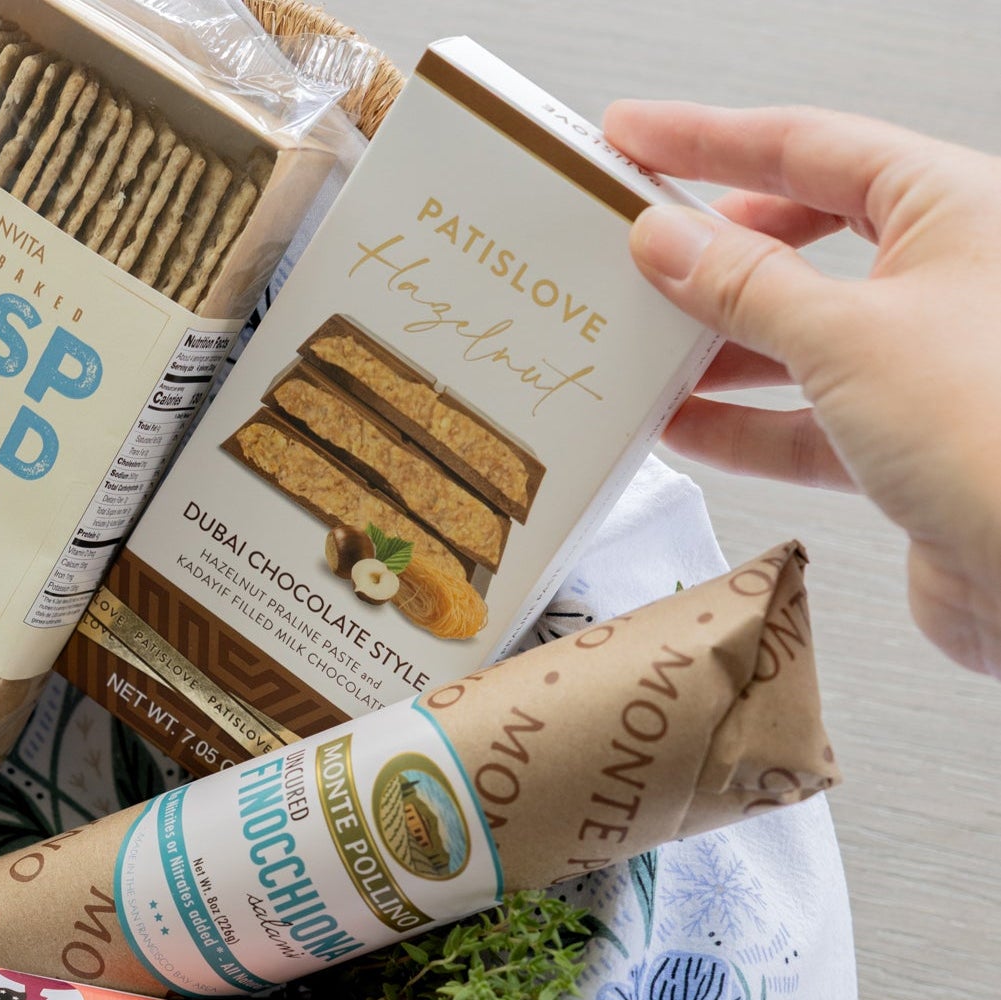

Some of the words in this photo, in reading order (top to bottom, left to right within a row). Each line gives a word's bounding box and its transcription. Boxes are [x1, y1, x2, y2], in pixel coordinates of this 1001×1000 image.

[416, 197, 608, 344] PATISLOVE
[348, 234, 603, 417] Hazelnut
[175, 554, 232, 598] KADAYIF
[230, 593, 274, 634] FILLED
[273, 627, 307, 658] MILK
[182, 501, 248, 556] DUBAI
[248, 550, 372, 650] CHOCOLATE
[369, 640, 431, 693] STYLE
[200, 547, 268, 604] HAZELNUT
[266, 596, 322, 642] PRALINE
[321, 635, 362, 673] PASTE
[360, 669, 383, 690] and
[106, 672, 149, 707] NET
[146, 701, 178, 737] WT.
[182, 730, 219, 767] 7.05
[133, 631, 199, 691] PATISLOVE
[207, 695, 274, 755] PATISLOVE
[284, 749, 310, 822] UNCURED
[578, 645, 693, 844] MONTE
[164, 799, 180, 839] Nitrites
[166, 841, 178, 854] or
[238, 757, 366, 963] FINOCCHIONA
[322, 741, 360, 835] MONTE
[345, 838, 421, 929] POLLINO
[169, 855, 195, 908] Nitrates
[187, 910, 216, 947] added
[193, 857, 206, 877] Net
[200, 877, 212, 896] Wt.
[207, 896, 221, 915] 8oz
[214, 914, 240, 945] (226g)
[246, 892, 305, 960] salami
[137, 921, 174, 972] FRANCISCO
